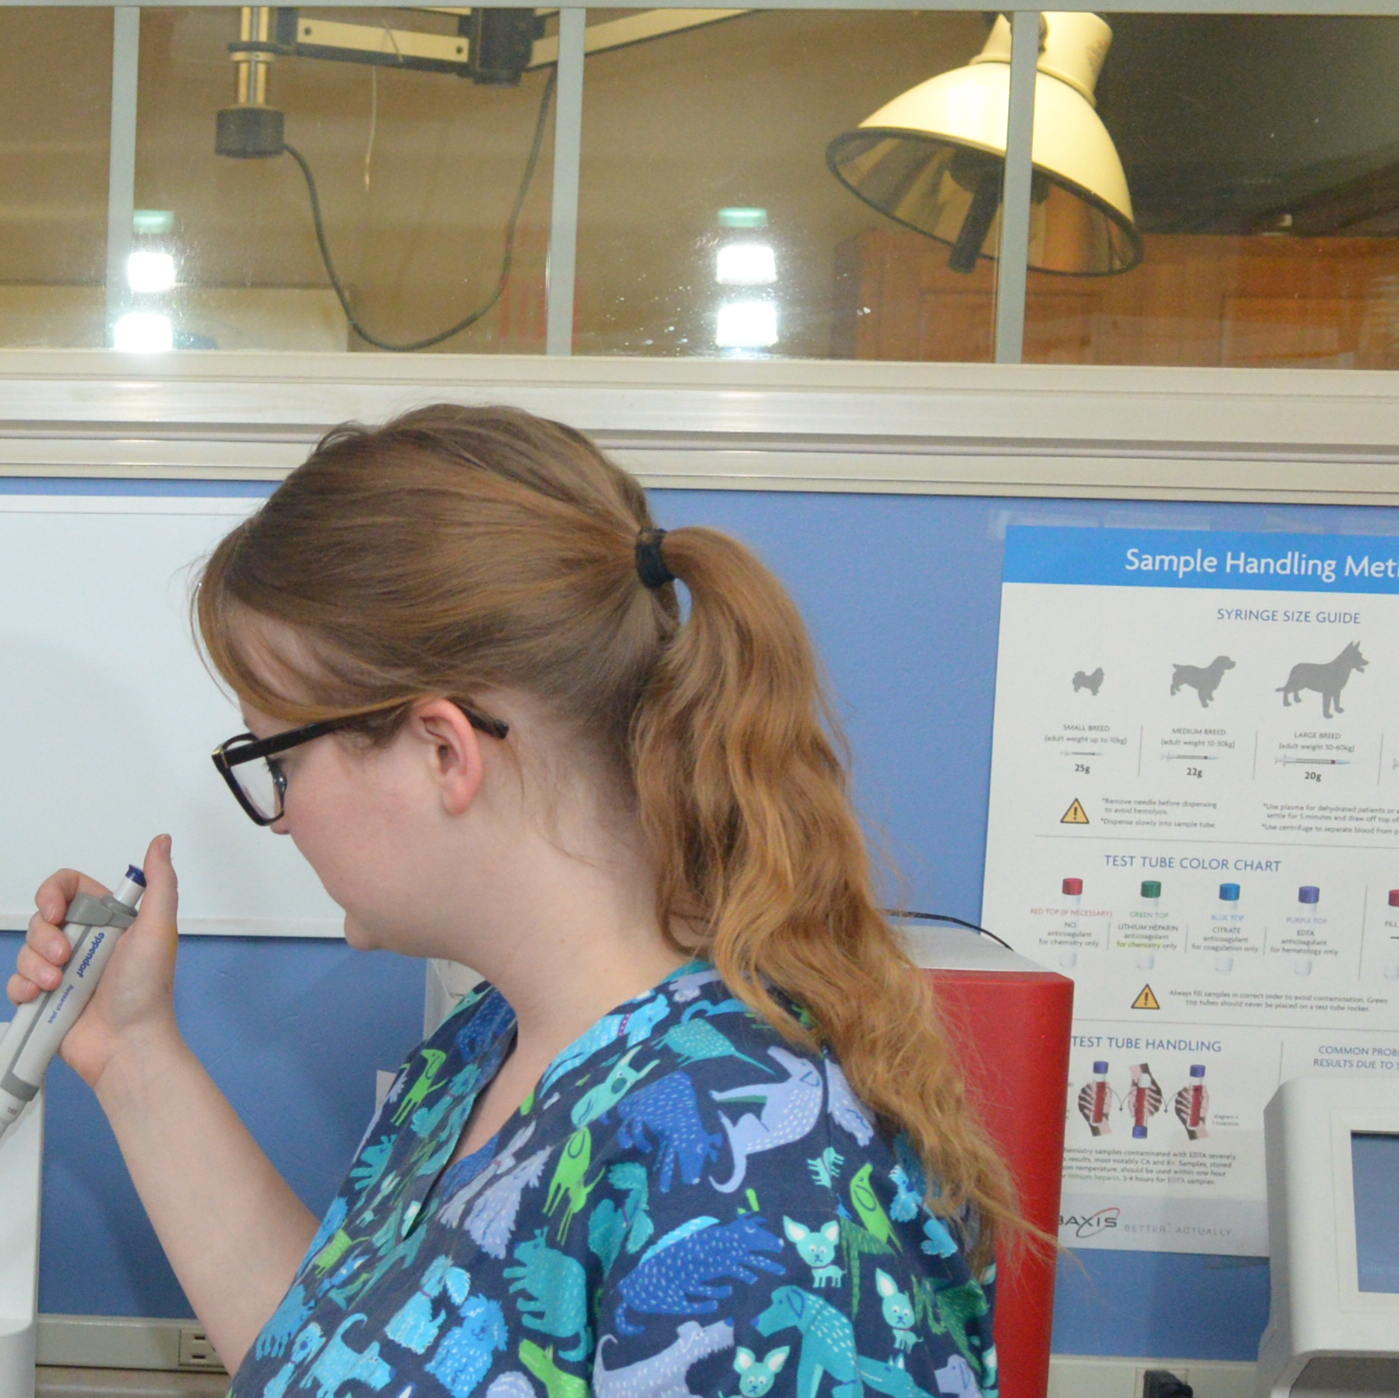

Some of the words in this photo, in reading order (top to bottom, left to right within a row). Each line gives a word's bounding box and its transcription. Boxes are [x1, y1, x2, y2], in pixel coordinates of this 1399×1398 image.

[1125, 548, 1217, 578] Sample
[1225, 550, 1337, 583] Handling
[1217, 608, 1278, 622] SYRINGE
[1283, 609, 1311, 622] SIZE
[1315, 611, 1361, 624] GUIDE
[1063, 724, 1085, 732] SMALL
[1319, 732, 1341, 740] BREED
[1075, 764, 1090, 775] 25g
[1187, 767, 1203, 778] 22g
[1304, 771, 1322, 783] 20g
[1104, 855, 1136, 867] TEST
[1141, 856, 1175, 869] TUBE
[1179, 857, 1229, 870] COLOR
[1234, 859, 1282, 872] CHART
[77, 932, 105, 978] eppendorf
[55, 984, 74, 1012] Research
[48, 1010, 60, 1024] plus
[1071, 1036, 1104, 1048] TEST
[1107, 1037, 1141, 1050] TUBE
[1146, 1039, 1222, 1053] HANDLING
[1318, 1045, 1369, 1056] COMMON
[1372, 1047, 1399, 1057] PROB
[1313, 1058, 1354, 1069] RESULTS
[1357, 1059, 1376, 1070] DUE
[1379, 1060, 1394, 1070] TO
[1058, 1215, 1117, 1228] BAXIS
